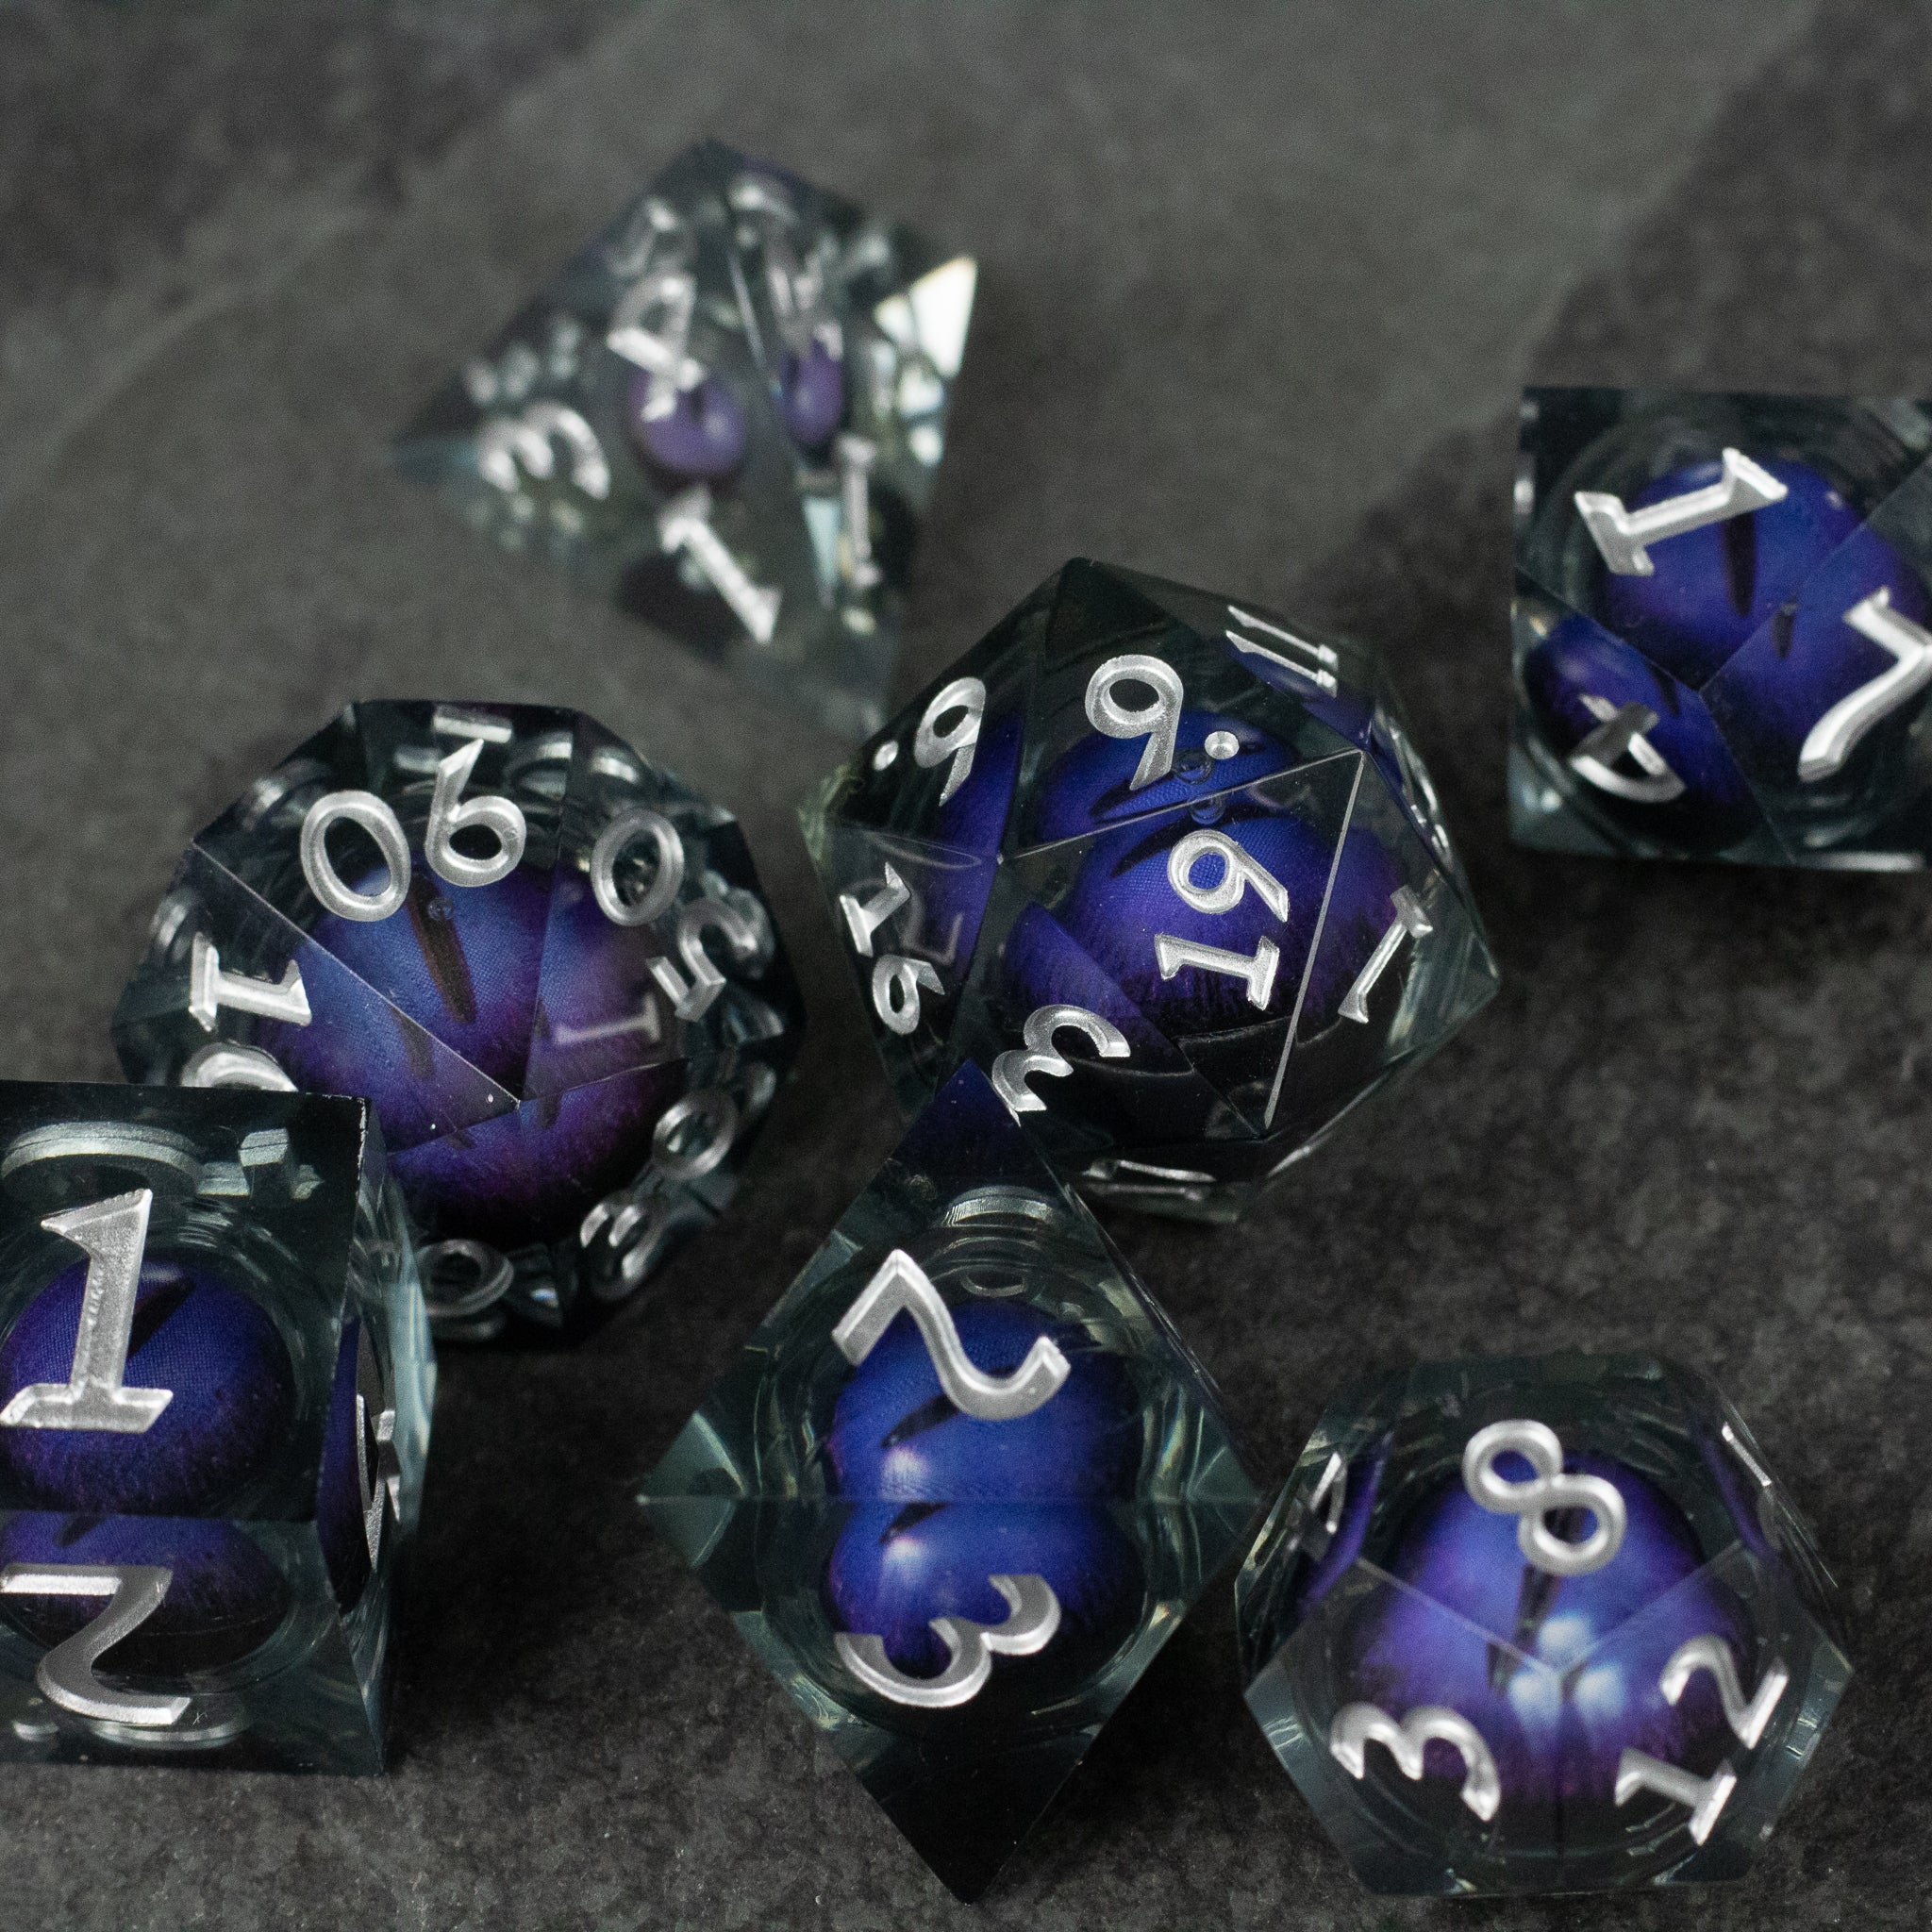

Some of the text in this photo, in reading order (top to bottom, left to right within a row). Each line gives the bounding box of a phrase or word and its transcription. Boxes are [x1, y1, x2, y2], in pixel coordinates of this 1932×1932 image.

[479, 402, 611, 500] 3
[1575, 447, 1789, 576] 1
[658, 489, 782, 645] 1
[1799, 586, 1932, 785] 7
[1153, 829, 1290, 1011] 19
[992, 1004, 1132, 1114] 3
[0, 1187, 175, 1436] 1
[1462, 1418, 1627, 1576] 8
[0, 1563, 191, 1727] 2
[834, 1573, 1062, 1709] 3
[1329, 1701, 1502, 1823] 3
[1614, 1634, 1790, 1848] 12
